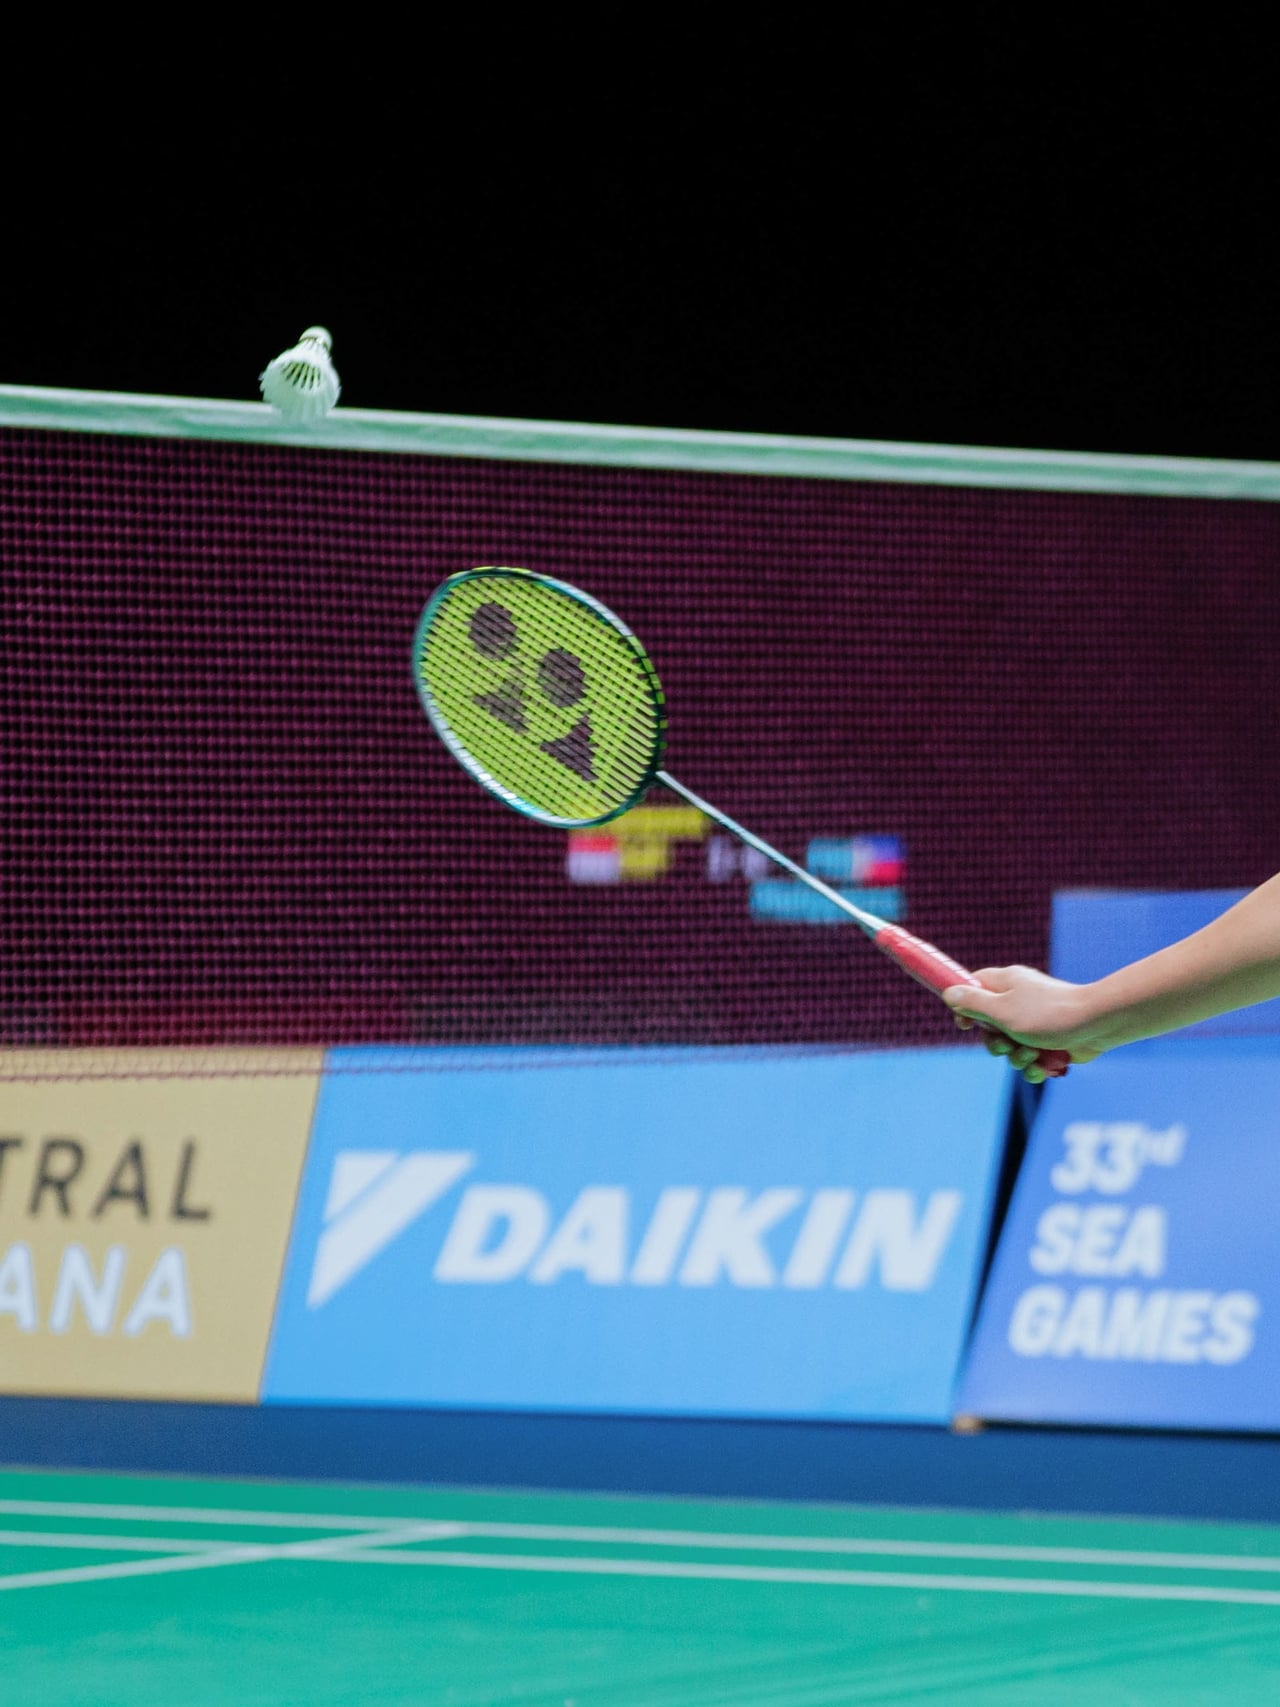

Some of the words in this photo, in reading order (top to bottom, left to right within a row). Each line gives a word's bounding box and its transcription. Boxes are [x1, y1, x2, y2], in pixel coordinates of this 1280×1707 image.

[433, 1185, 962, 1291] DAIKIN
[1029, 1204, 1166, 1277] SEA
[0, 1243, 192, 1337] ANA
[1009, 1285, 1259, 1364] GAMES
